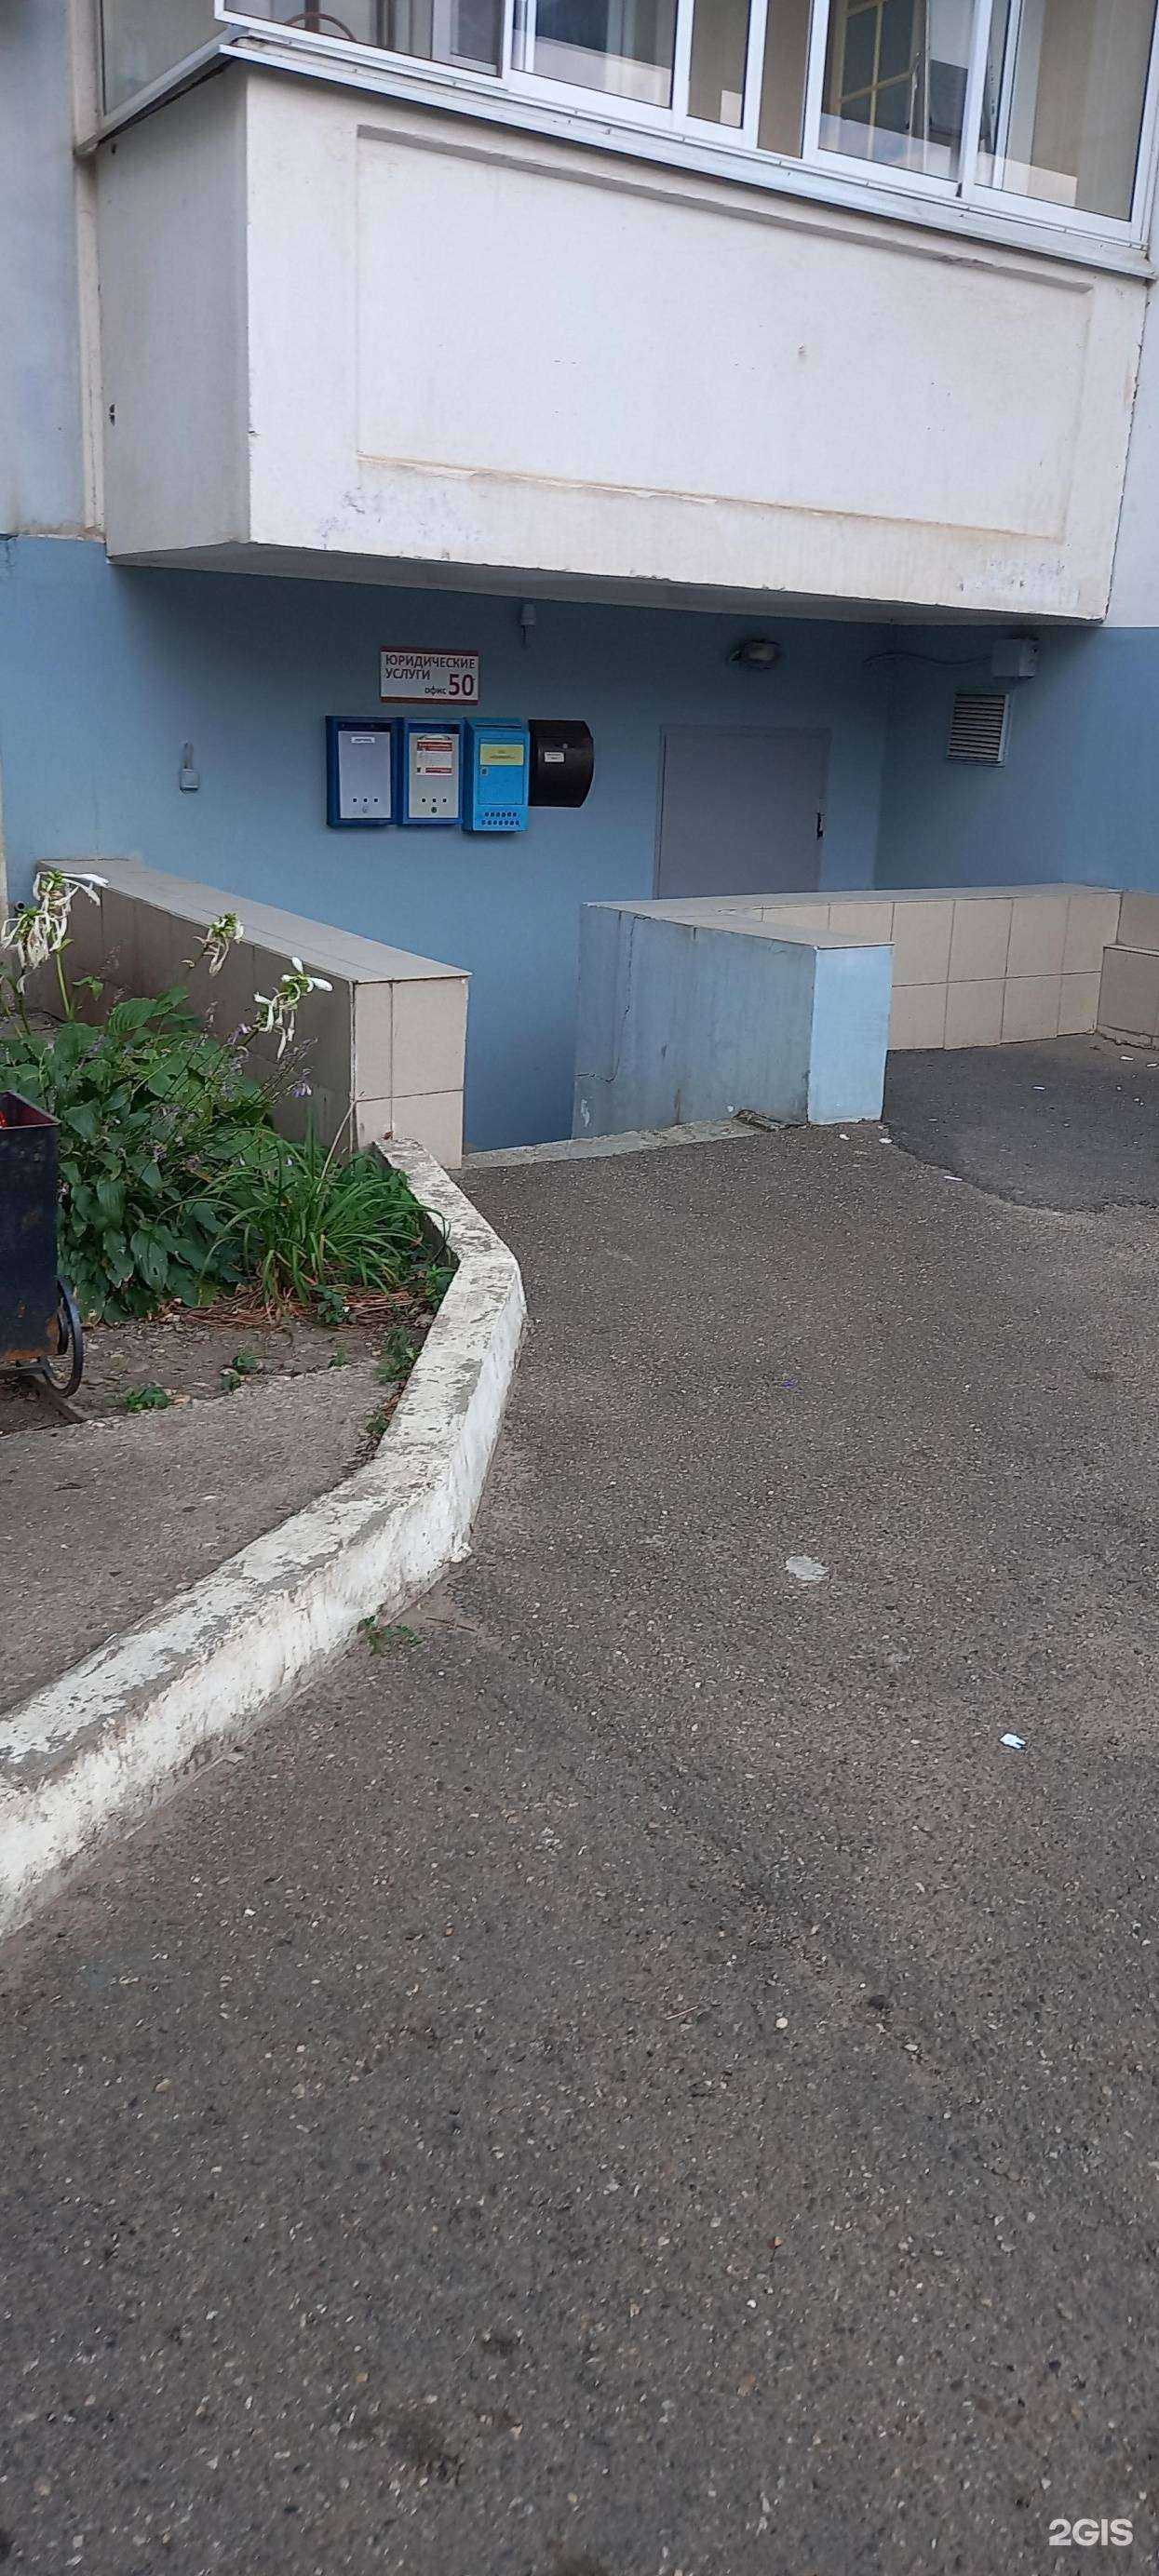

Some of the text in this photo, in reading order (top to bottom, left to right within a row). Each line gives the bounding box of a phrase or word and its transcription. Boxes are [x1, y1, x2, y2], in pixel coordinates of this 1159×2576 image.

[385, 654, 476, 669] ЮРИДИЧЕСКИЕ
[385, 668, 431, 680] УСЛУГИ
[425, 674, 475, 696] офис 50
